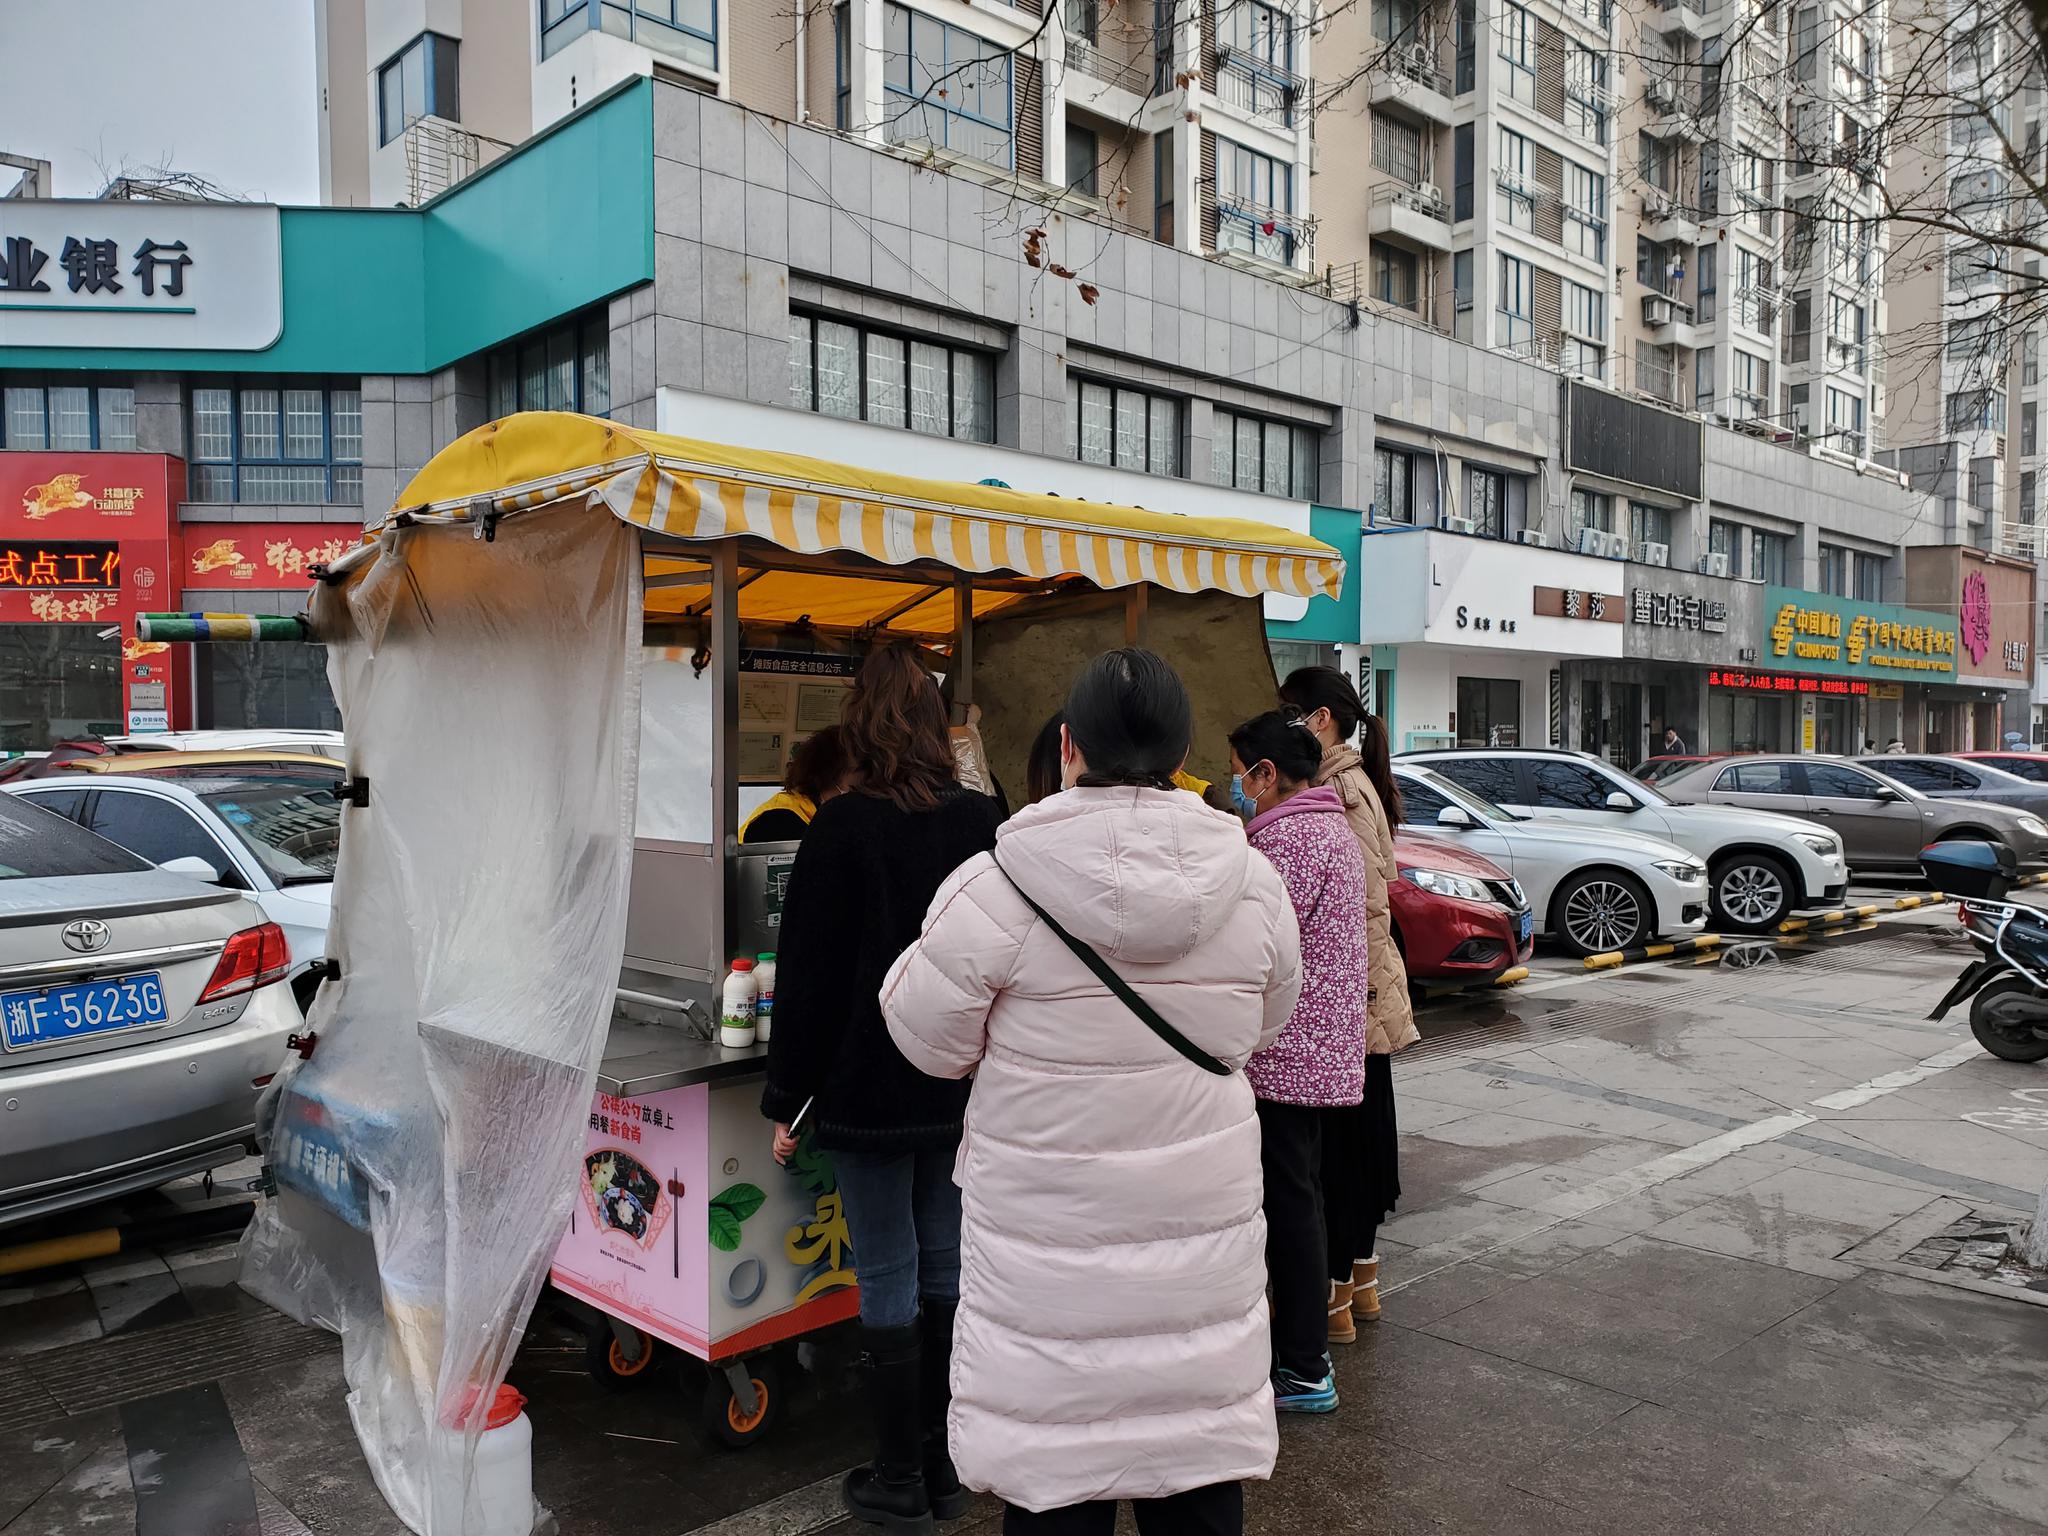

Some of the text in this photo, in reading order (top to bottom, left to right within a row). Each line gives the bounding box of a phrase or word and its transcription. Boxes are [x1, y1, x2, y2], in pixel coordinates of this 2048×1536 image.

[0, 236, 193, 297] 业银行
[1566, 590, 1606, 619] 黎莎
[1796, 608, 1841, 639] 中国邮政
[753, 658, 842, 674] 摊贩食品安全信息公示
[1820, 645, 1840, 661] POST
